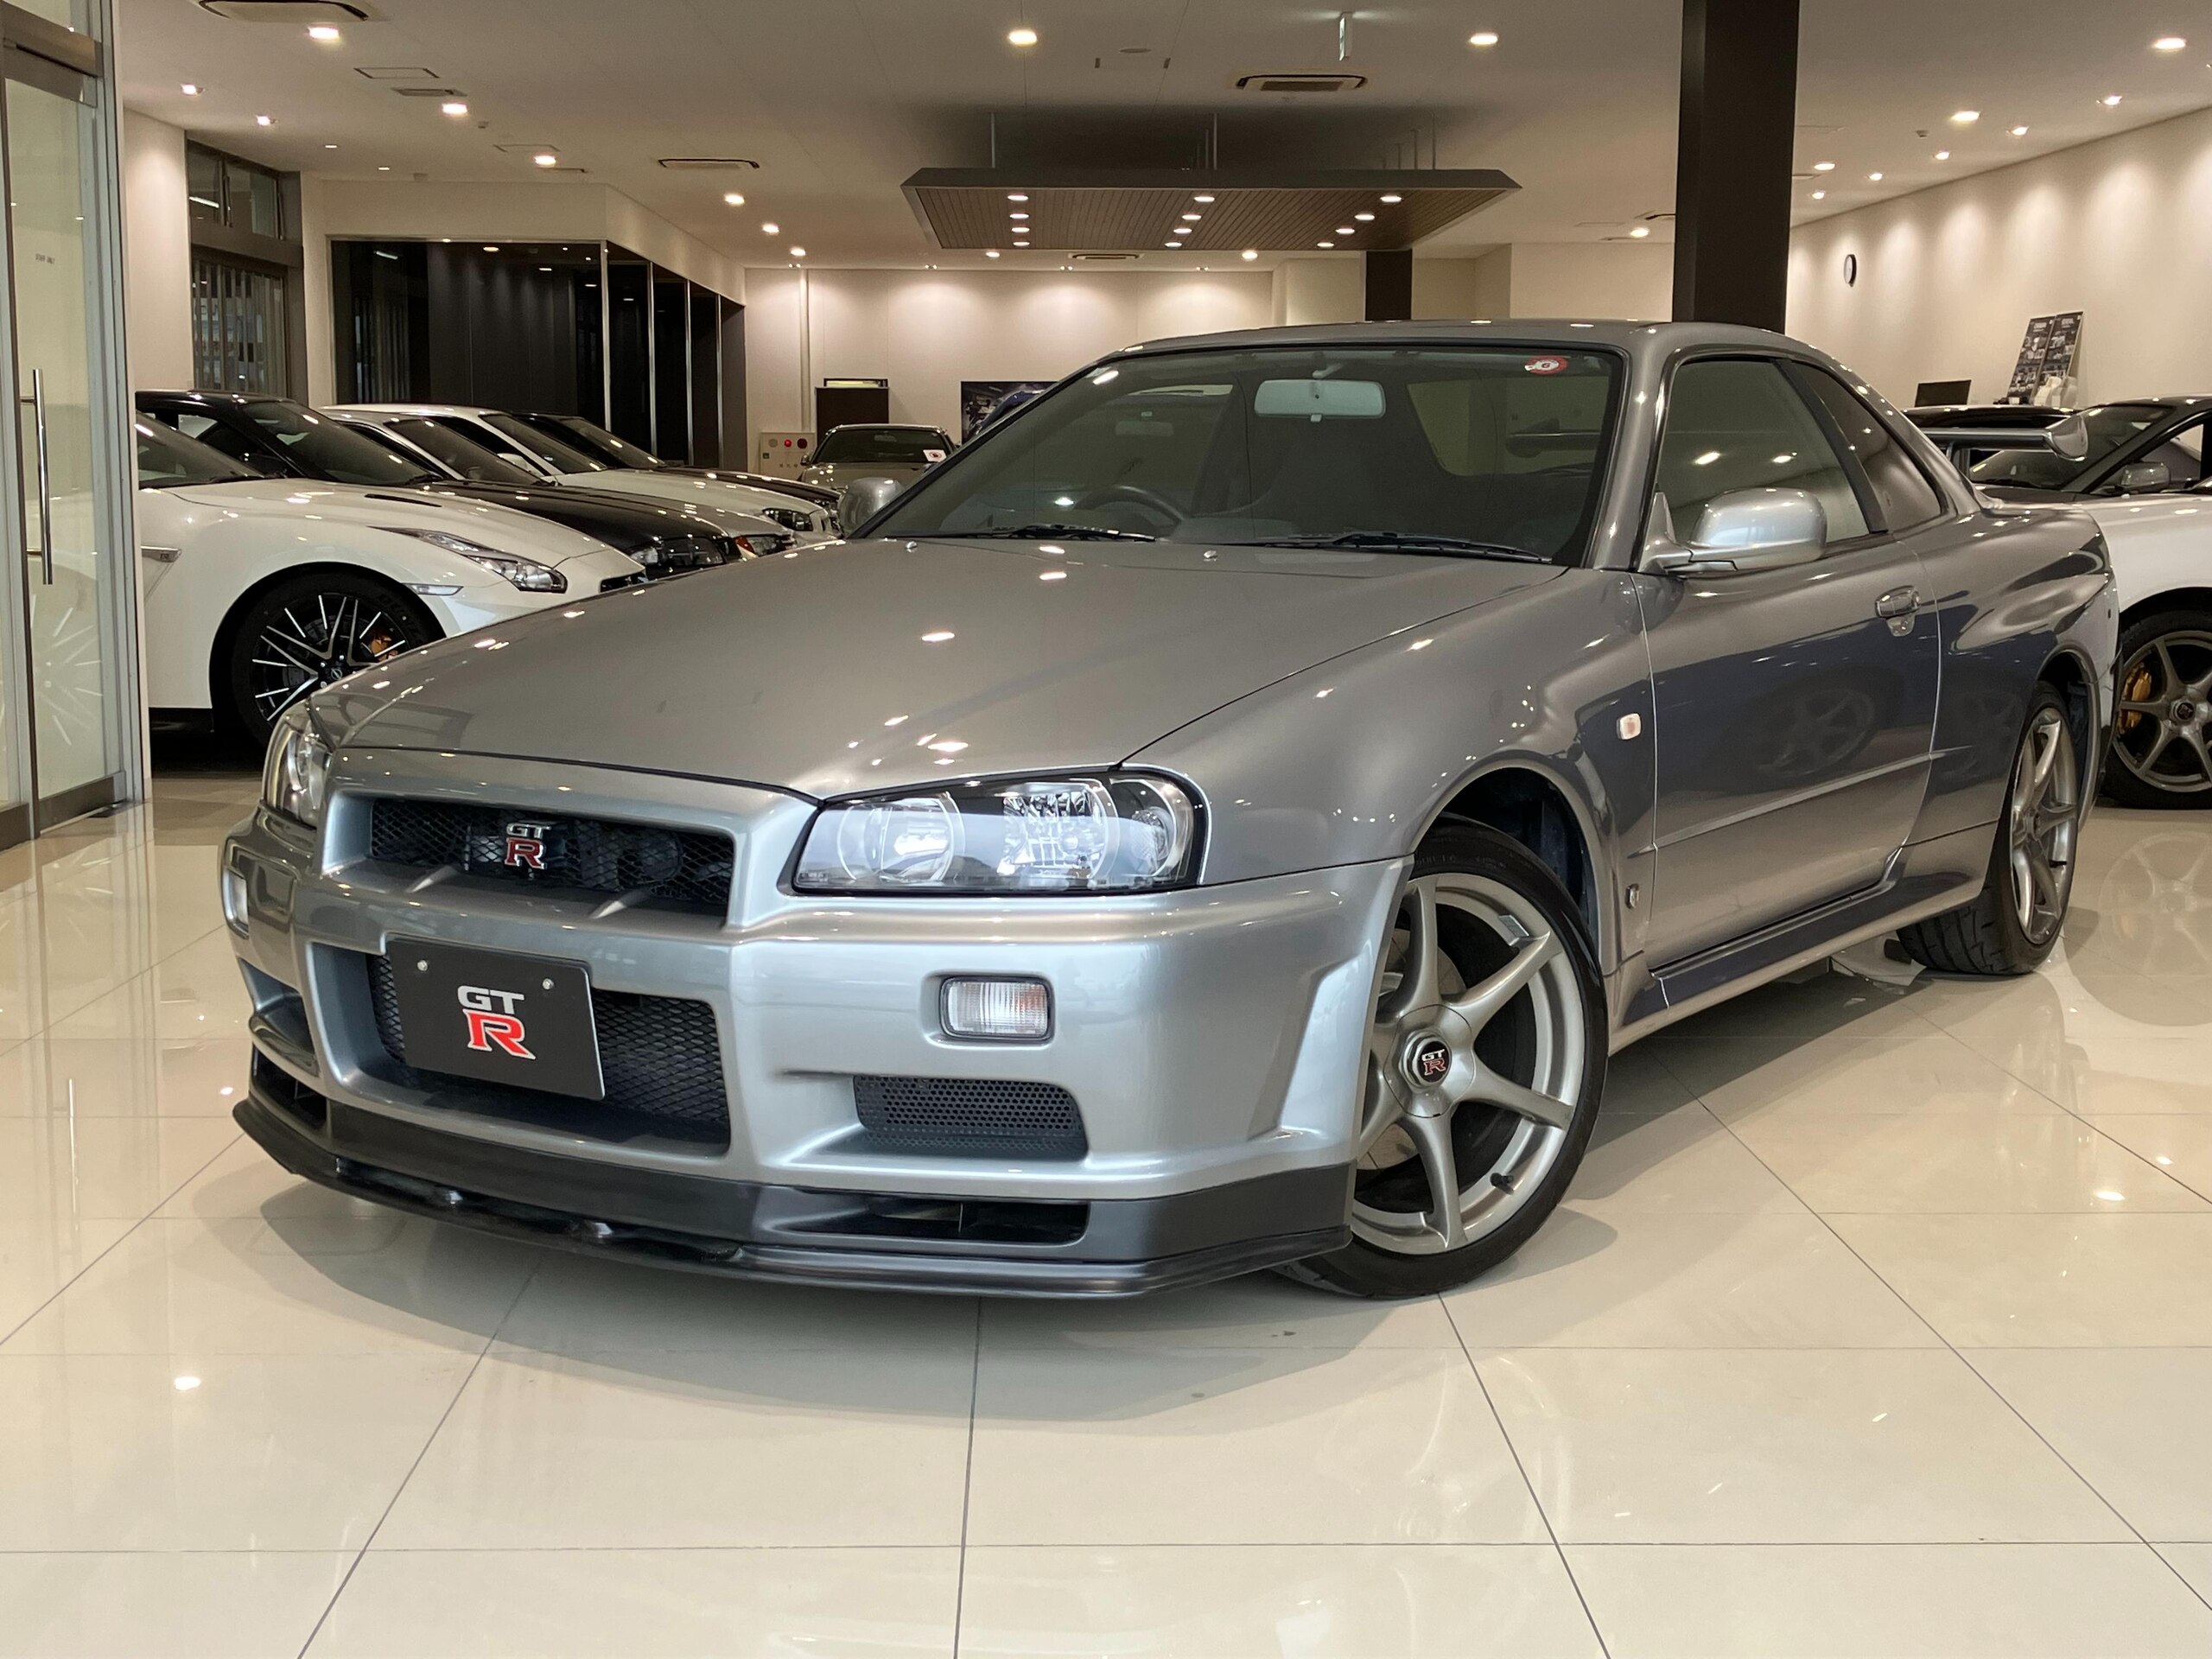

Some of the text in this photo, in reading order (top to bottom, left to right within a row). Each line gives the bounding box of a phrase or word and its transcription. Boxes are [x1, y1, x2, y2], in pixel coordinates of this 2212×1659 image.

[506, 823, 551, 839] GT
[505, 836, 545, 869] R
[457, 985, 524, 1014] GT
[462, 1008, 536, 1059] R
[1421, 1048, 1445, 1061] GT
[1423, 1057, 1446, 1076] R
